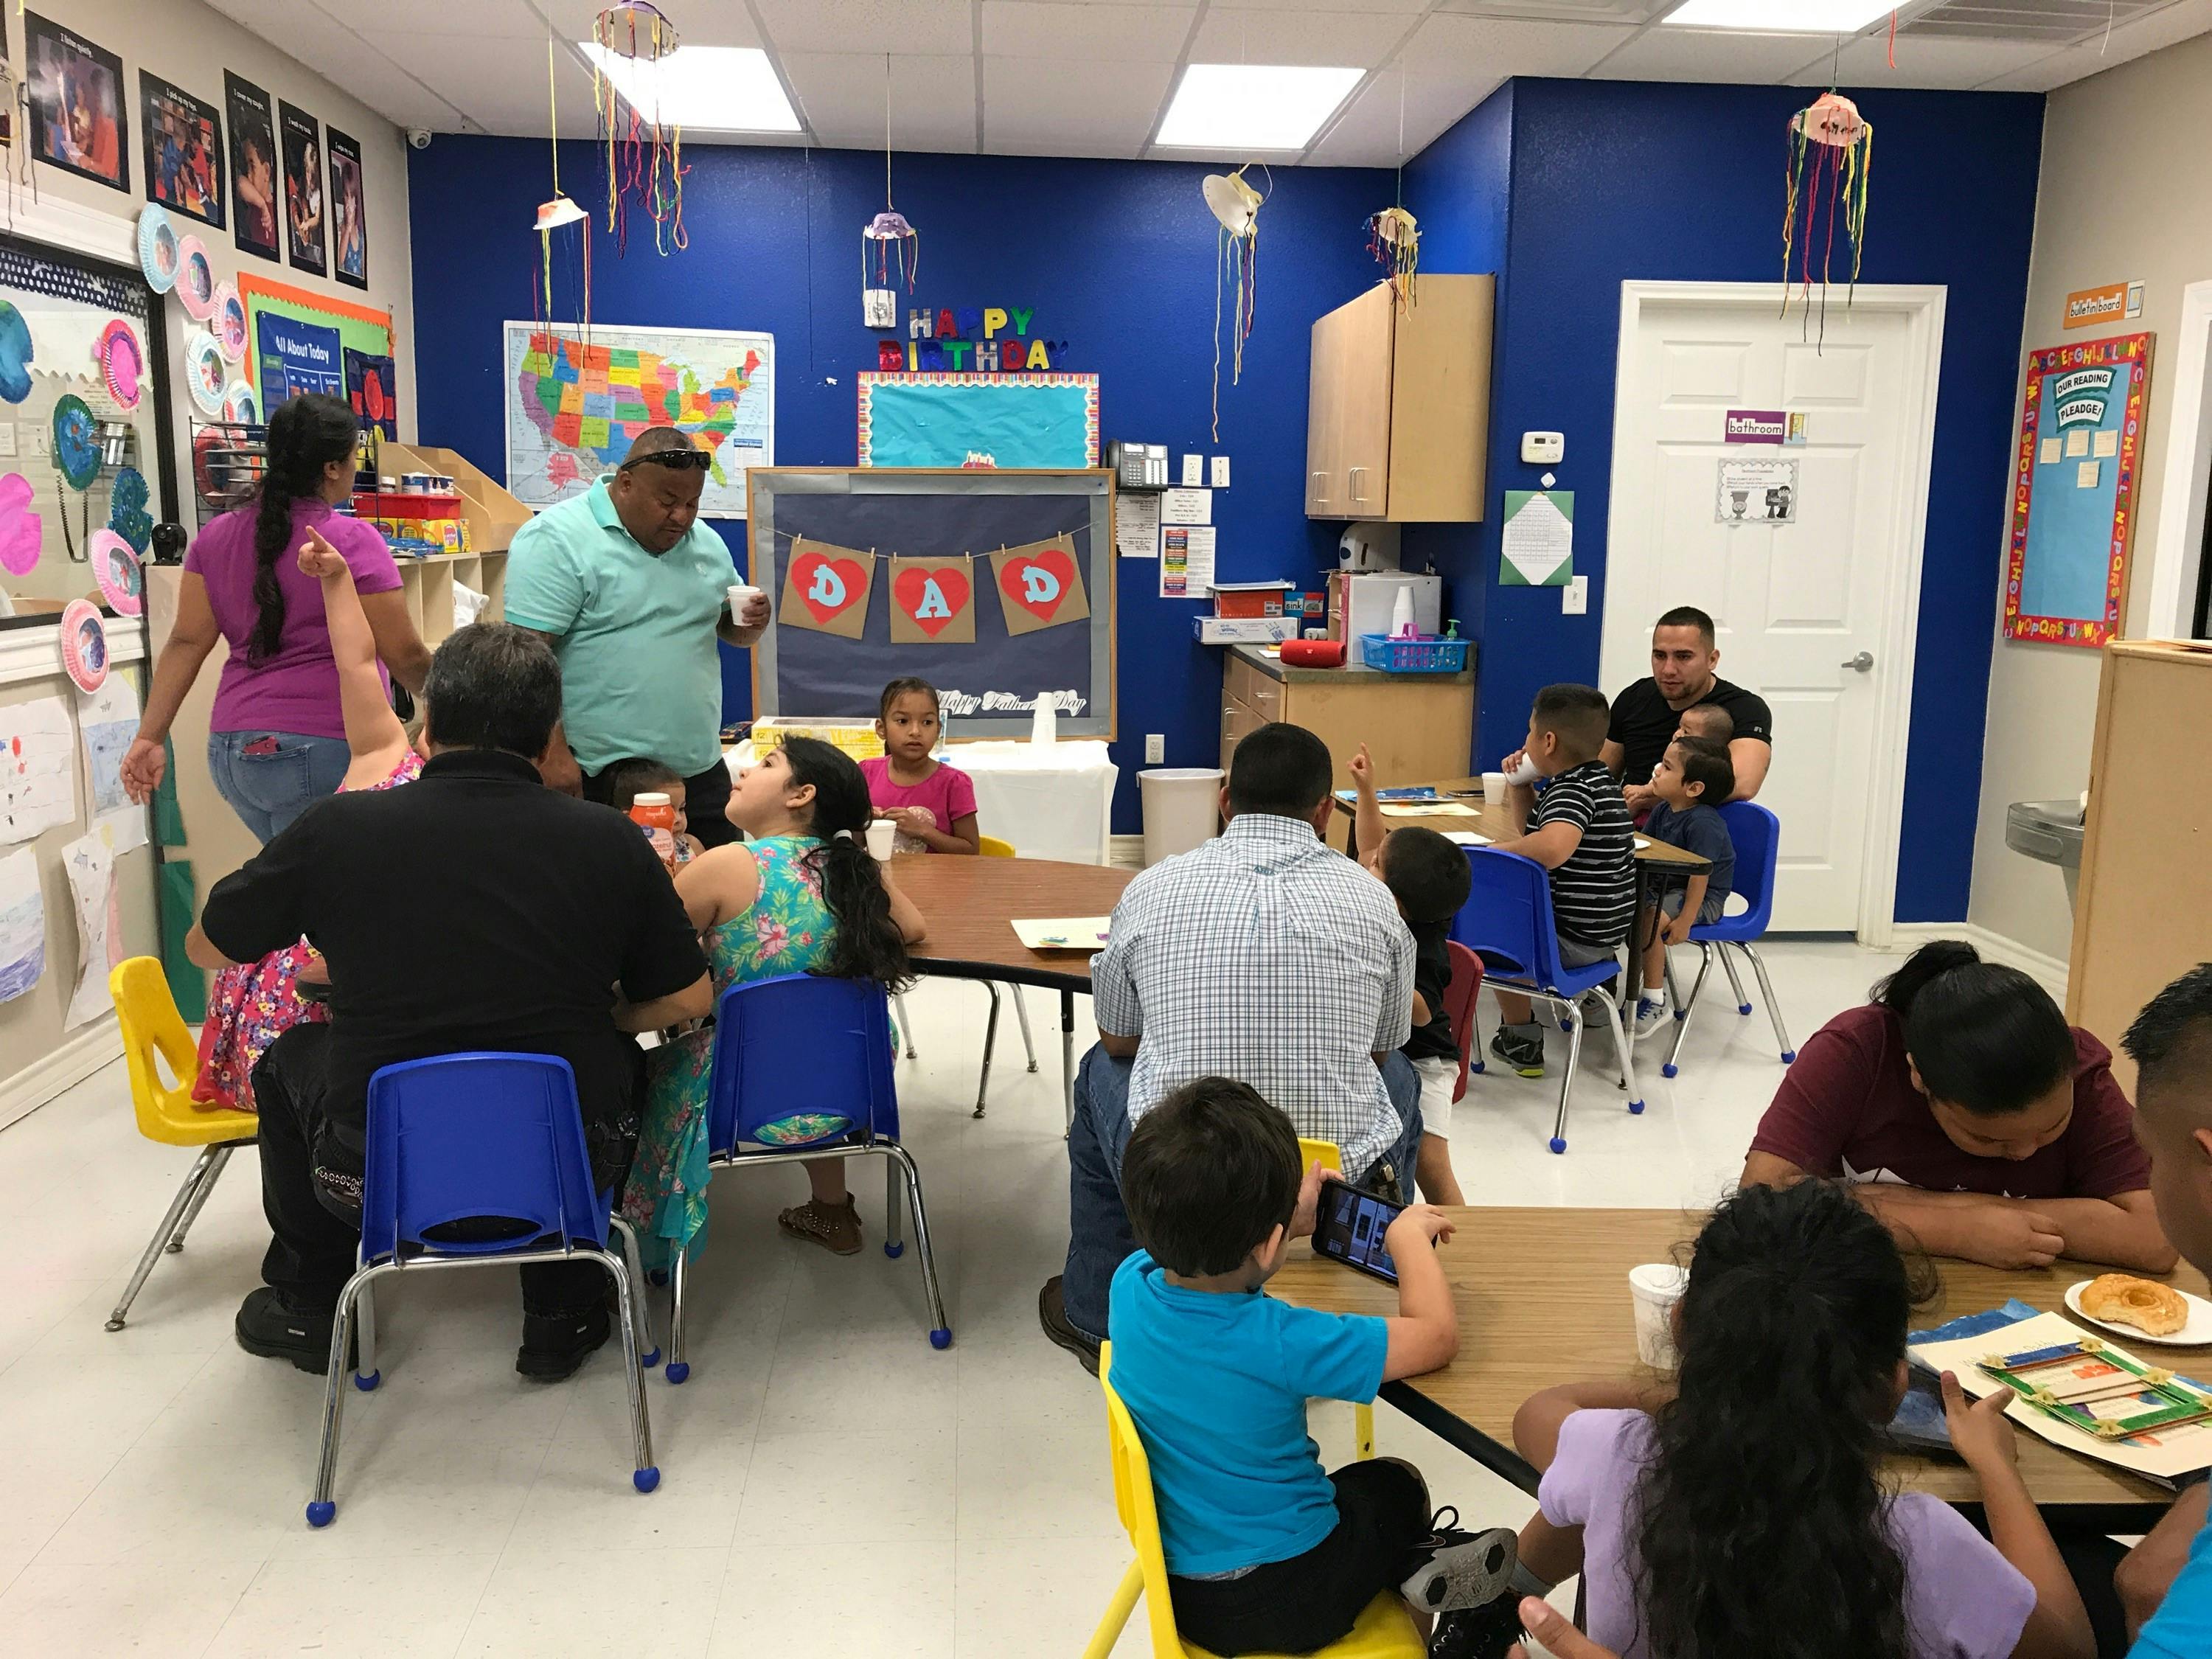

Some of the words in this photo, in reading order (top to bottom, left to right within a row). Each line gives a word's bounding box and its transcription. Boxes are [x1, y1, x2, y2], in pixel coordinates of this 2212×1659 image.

[2070, 299, 2096, 317] bulletin
[2098, 296, 2121, 313] board
[909, 306, 1034, 339] HAPPY
[275, 335, 286, 353] All
[287, 339, 308, 358] About
[308, 343, 329, 364] Today
[878, 339, 1069, 372] BIRTHDAY
[2057, 379, 2072, 394] OUR
[2073, 373, 2108, 389] READING
[2060, 403, 2102, 421] PLEADGE!
[1729, 420, 1782, 434] bathroom
[1285, 599, 1302, 611] sink
[938, 692, 981, 714] Happy
[982, 691, 1035, 711] Father
[1055, 692, 1086, 715] Day
